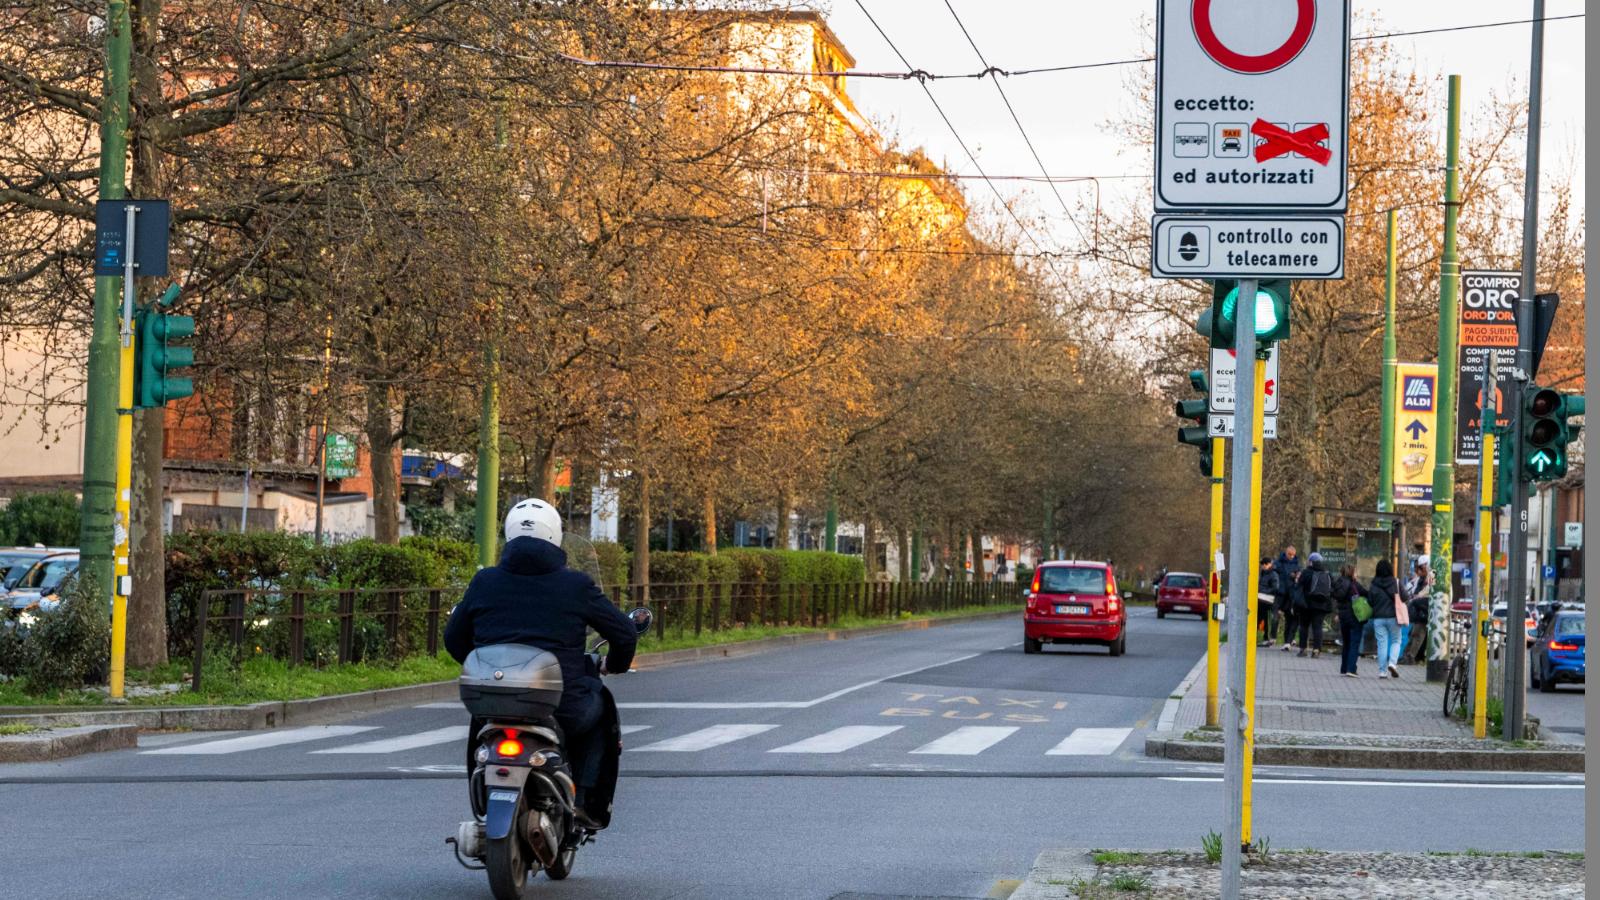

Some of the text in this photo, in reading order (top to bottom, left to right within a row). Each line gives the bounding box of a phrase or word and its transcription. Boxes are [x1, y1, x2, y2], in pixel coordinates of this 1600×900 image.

[1174, 96, 1254, 111] eccetto:
[1173, 168, 1314, 184] ed autorizzati
[1218, 228, 1328, 244] controllo con
[1227, 250, 1318, 266] telecamere
[1466, 277, 1520, 288] COMPRO
[1405, 398, 1431, 406] ALDI
[900, 692, 1068, 710] TAXI
